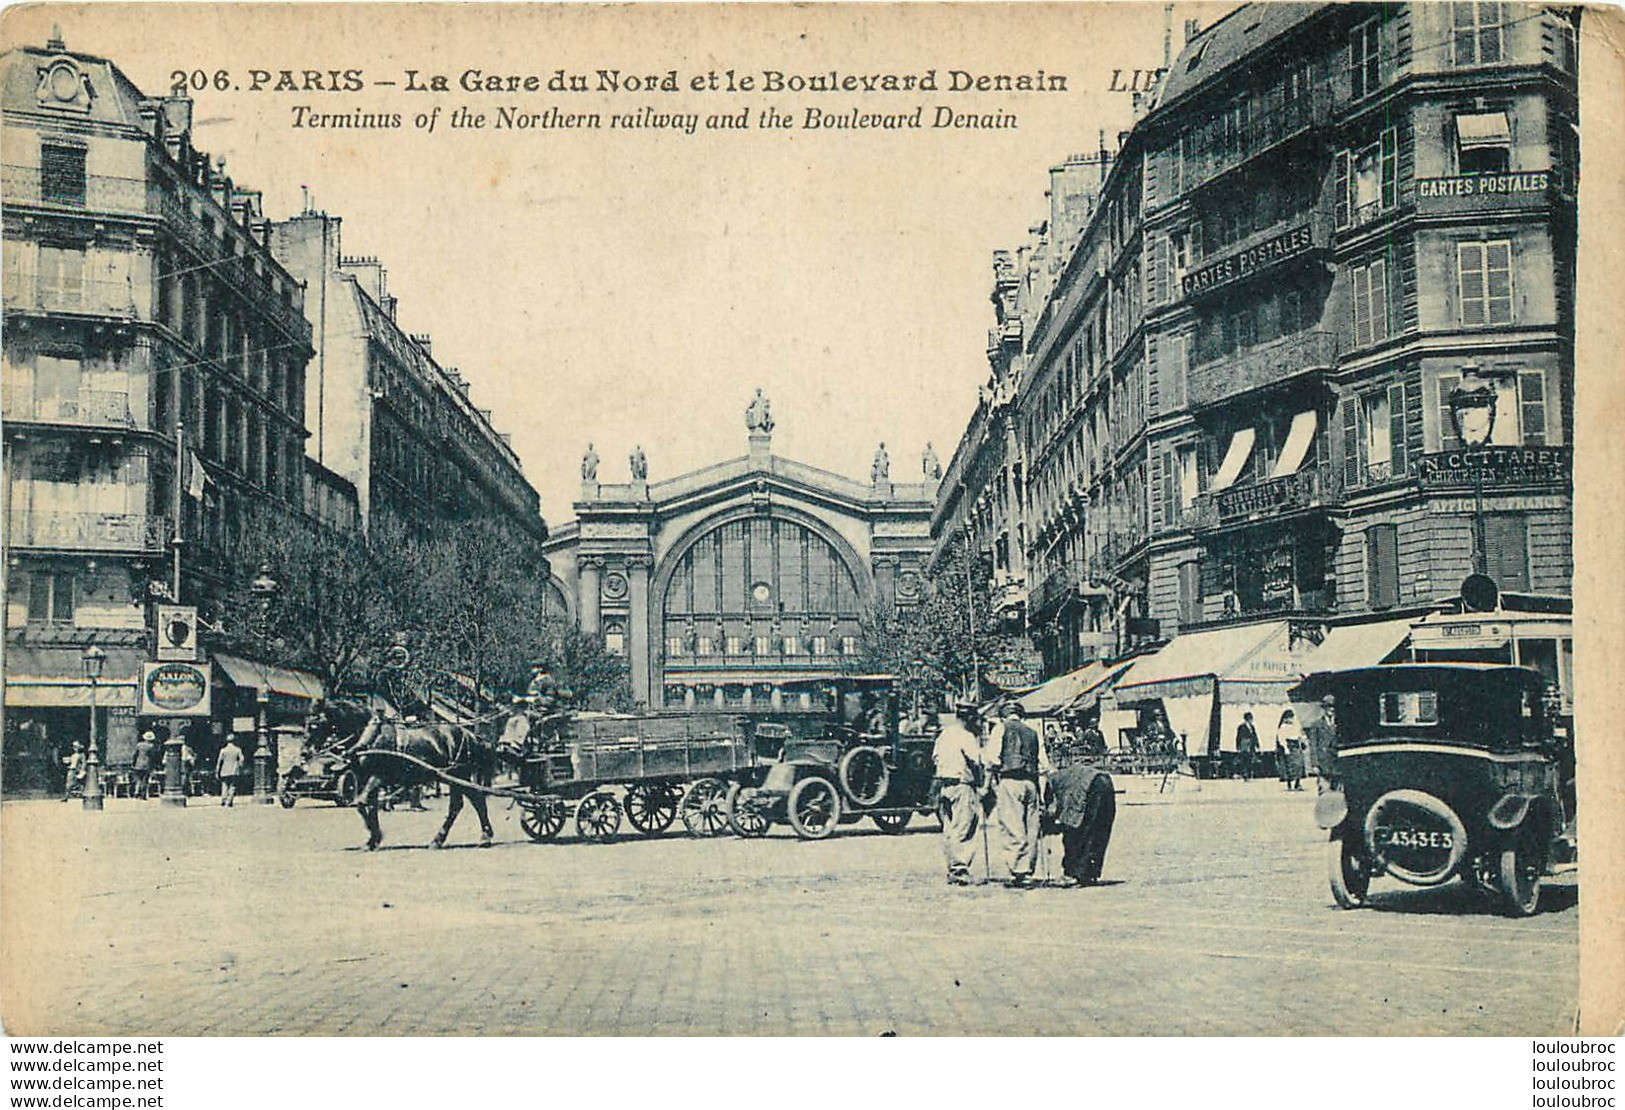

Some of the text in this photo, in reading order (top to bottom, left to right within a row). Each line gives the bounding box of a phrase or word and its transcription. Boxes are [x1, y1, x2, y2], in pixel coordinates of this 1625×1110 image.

[1420, 174, 1549, 197] CARTES POSTALES
[1183, 226, 1310, 294] CARTES POSTALES
